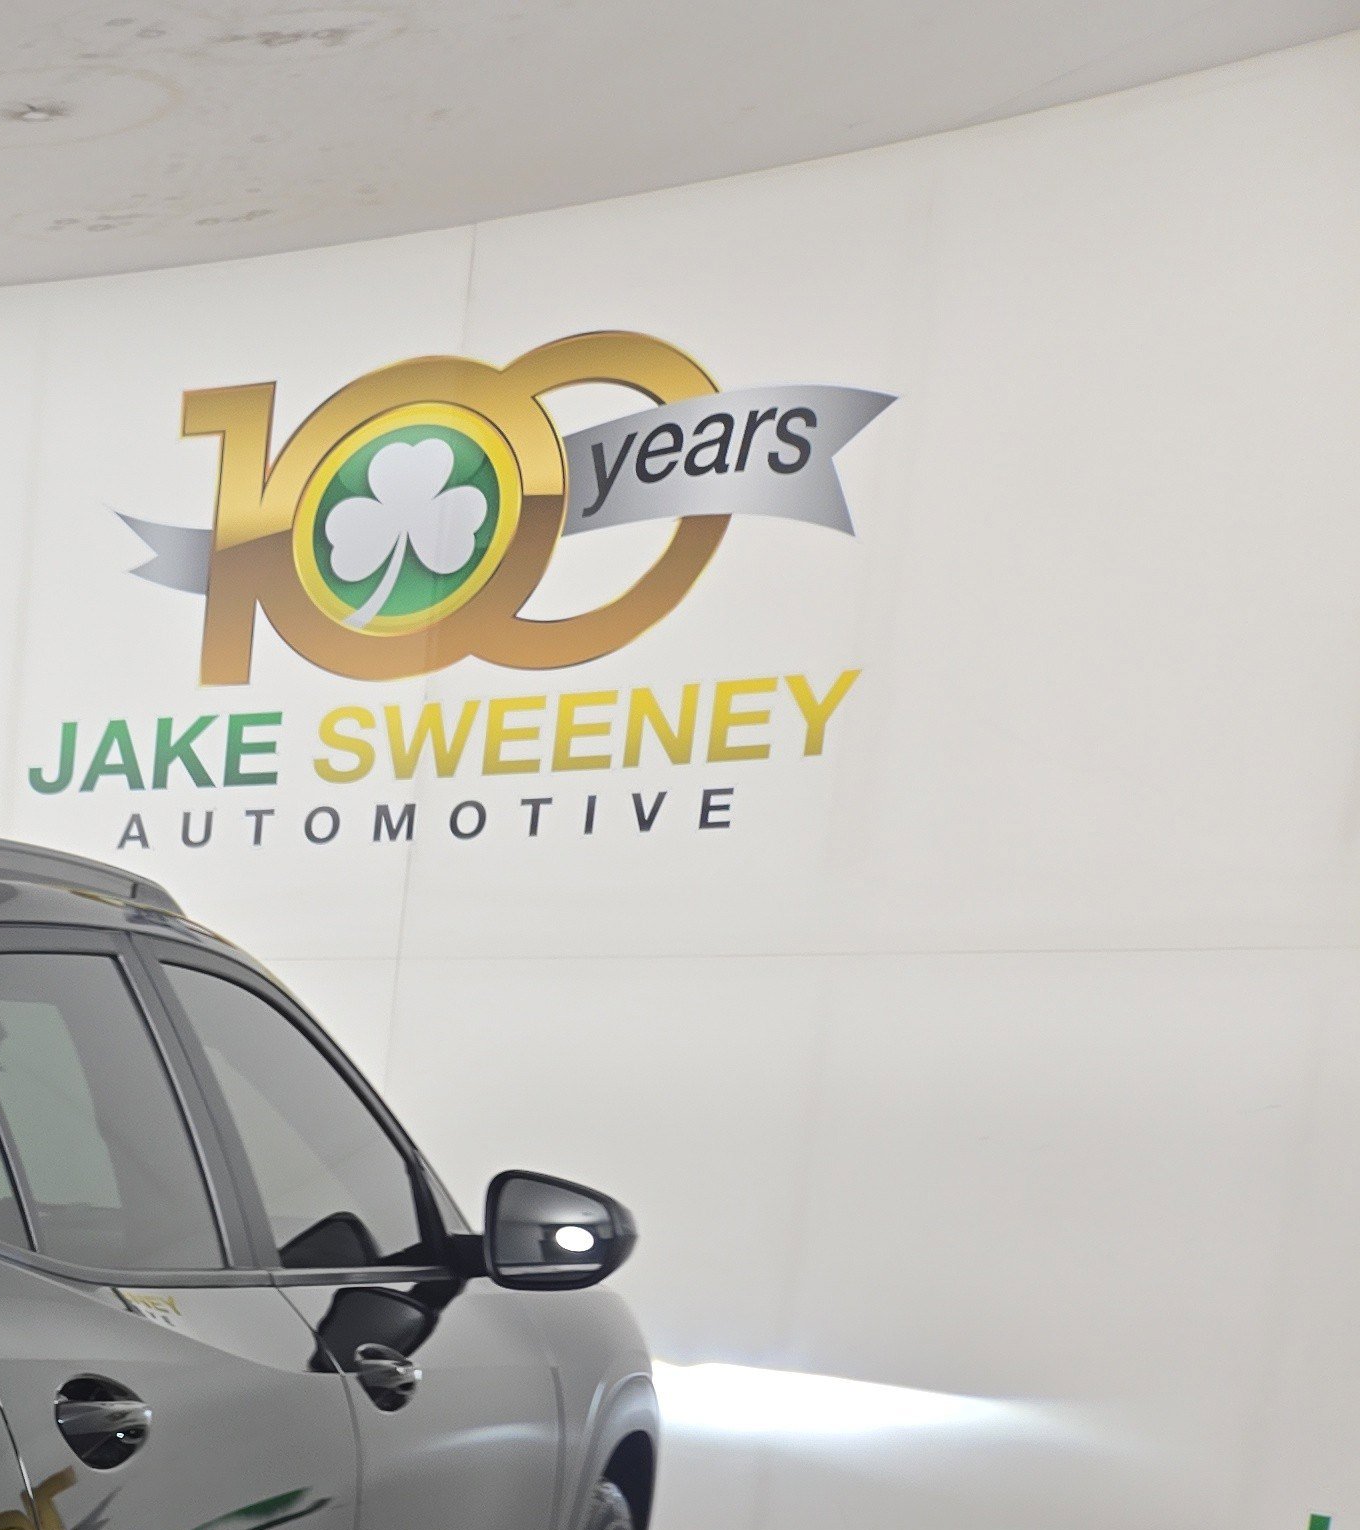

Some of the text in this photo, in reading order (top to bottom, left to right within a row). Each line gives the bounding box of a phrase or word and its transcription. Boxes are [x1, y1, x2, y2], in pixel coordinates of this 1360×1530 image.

[180, 329, 733, 688] 100
[582, 405, 818, 518] years
[27, 669, 862, 796] JAKE SWEENEY
[116, 787, 736, 852] AUTOMOTIVE
